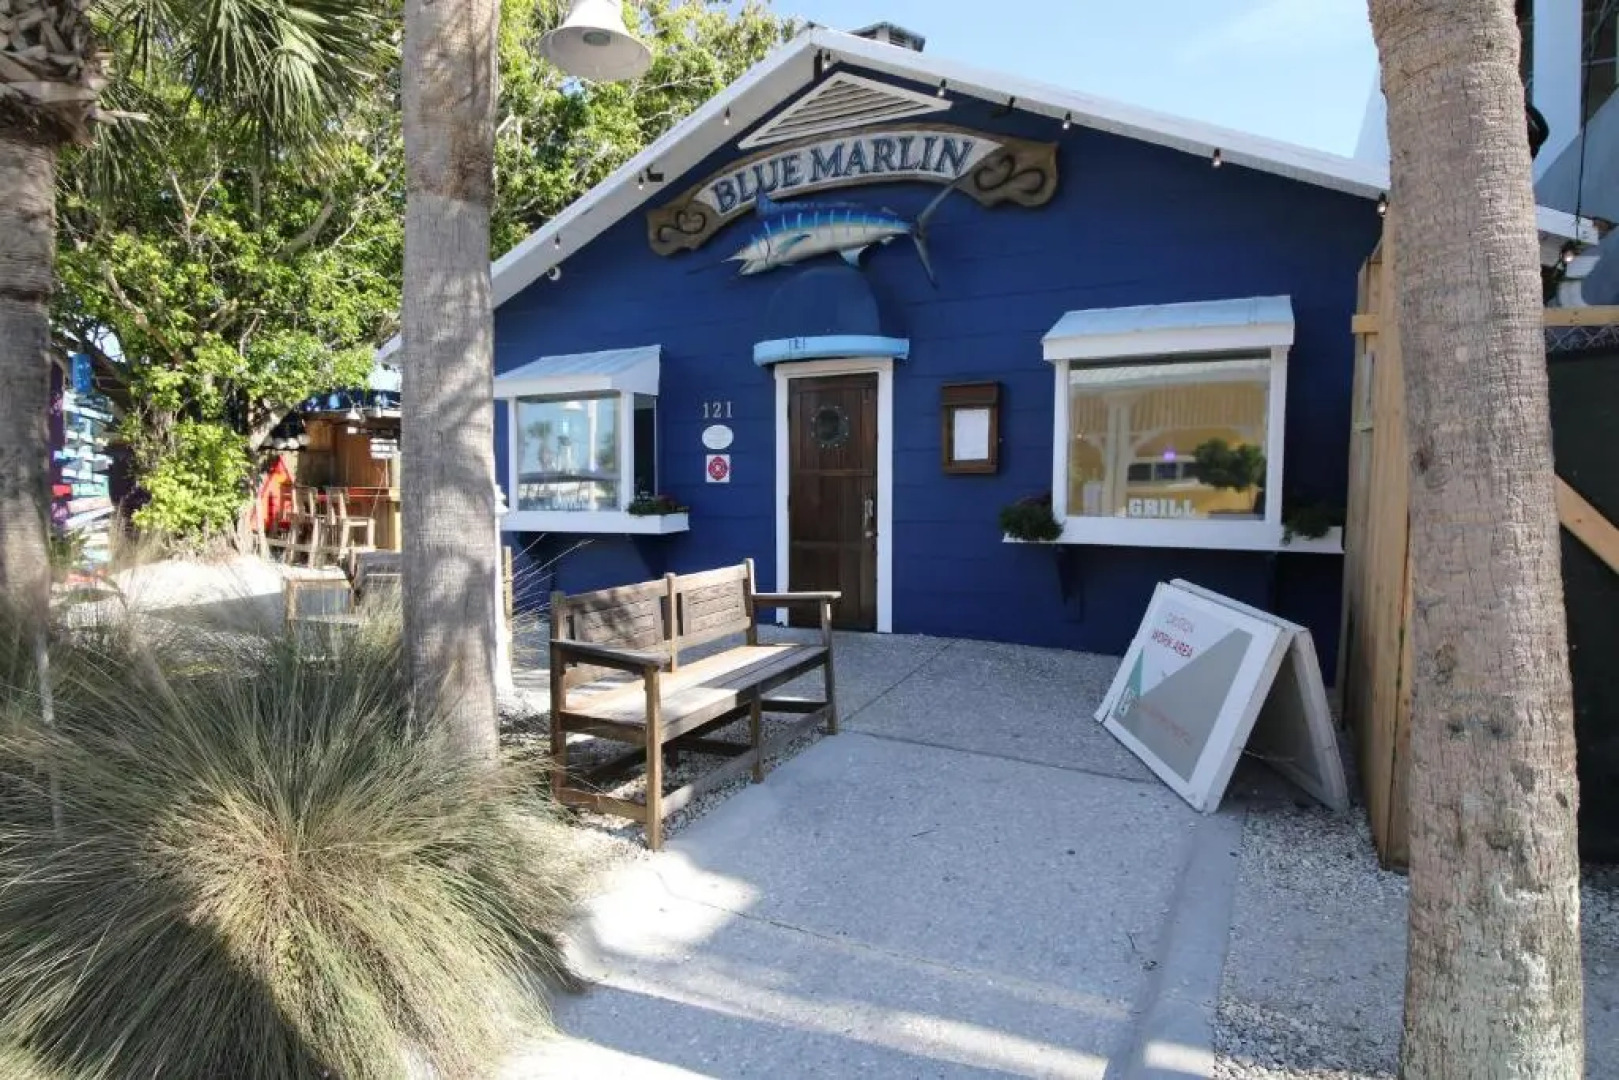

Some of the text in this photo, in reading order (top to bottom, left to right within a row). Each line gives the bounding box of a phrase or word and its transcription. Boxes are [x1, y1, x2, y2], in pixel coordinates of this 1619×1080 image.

[712, 136, 975, 211] BLUE MARLIN
[703, 401, 732, 418] 121
[1128, 498, 1195, 519] GRILL
